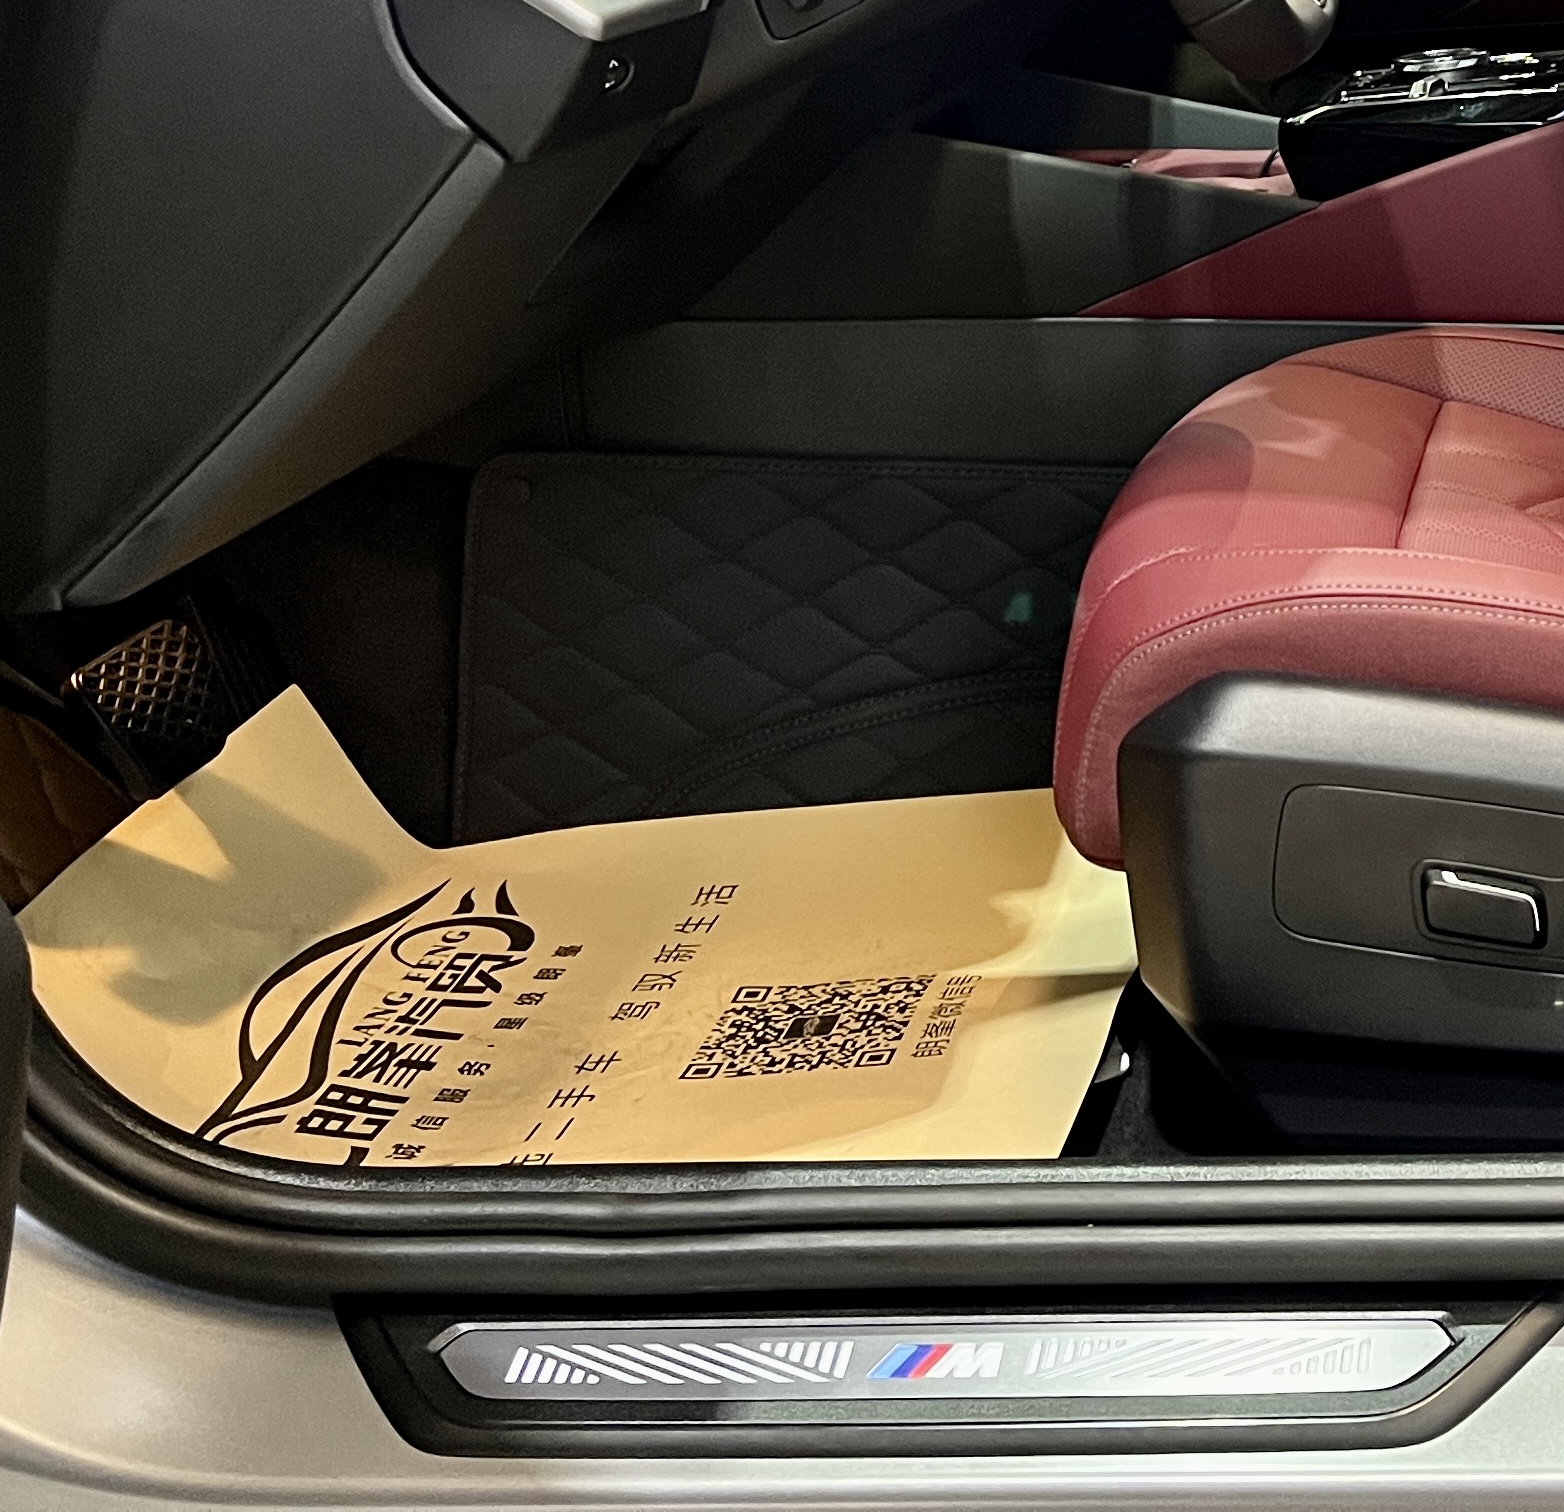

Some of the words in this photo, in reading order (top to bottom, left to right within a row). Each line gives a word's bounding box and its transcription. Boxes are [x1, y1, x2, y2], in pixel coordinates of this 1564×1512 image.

[335, 991, 414, 1048] LANG
[402, 930, 471, 982] FENG
[610, 885, 739, 1021] 驾驭新生活
